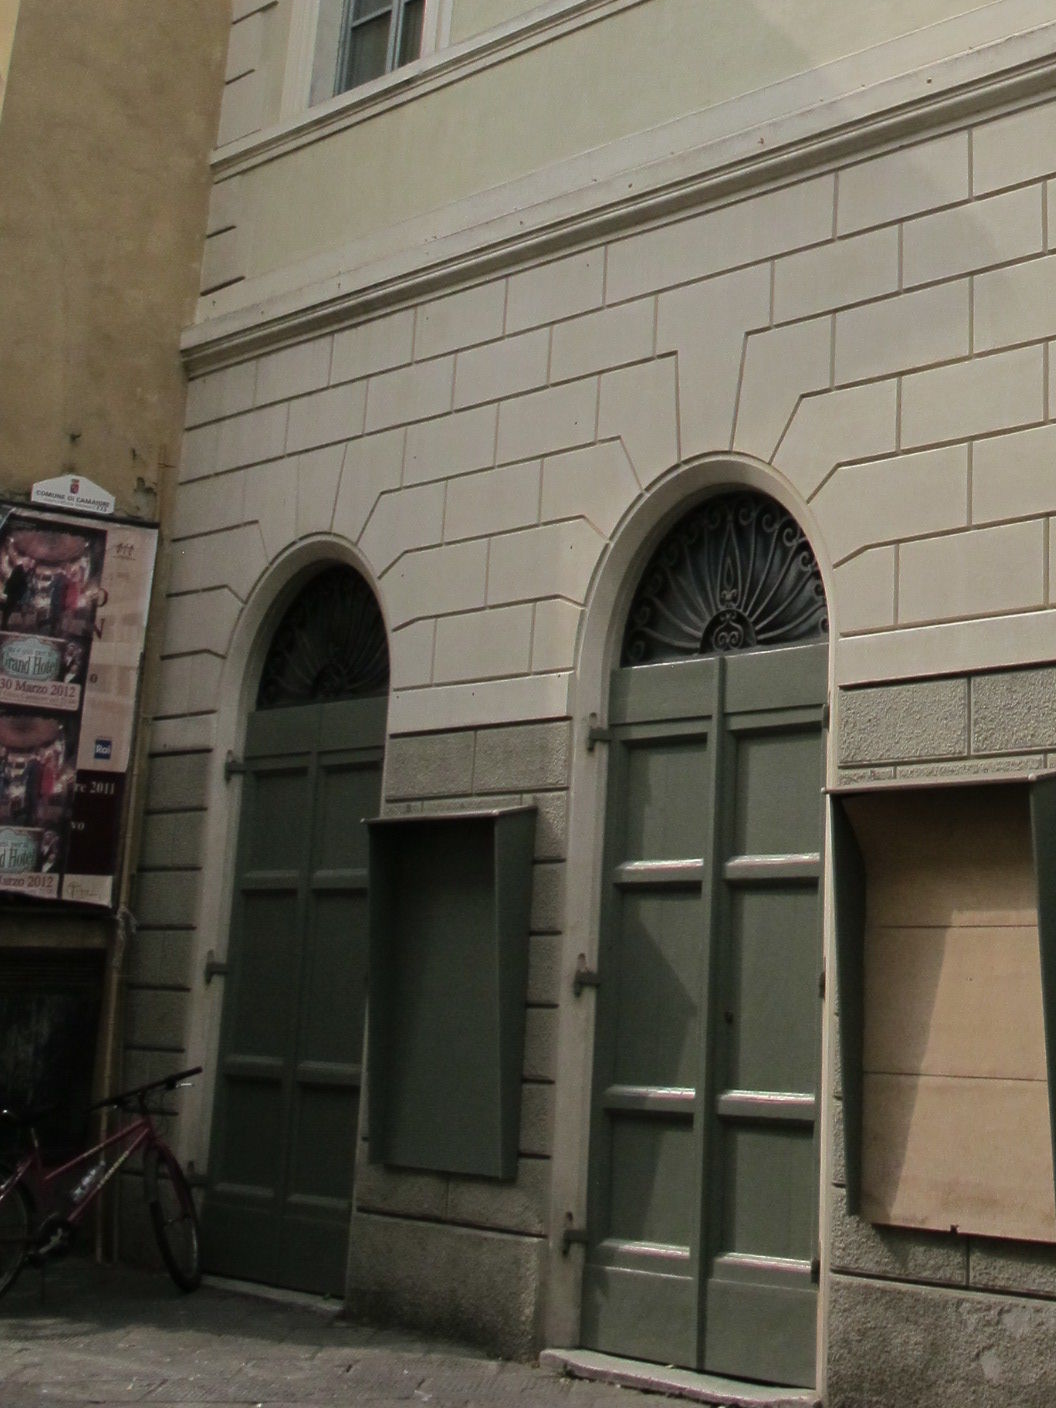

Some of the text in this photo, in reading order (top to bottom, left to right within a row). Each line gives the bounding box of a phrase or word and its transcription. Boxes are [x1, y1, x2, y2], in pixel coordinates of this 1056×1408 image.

[36, 490, 66, 500] COMUNE
[15, 680, 48, 694] Marzo
[50, 684, 76, 698] 2012
[89, 781, 115, 795] 2011
[27, 875, 54, 888] 2012
